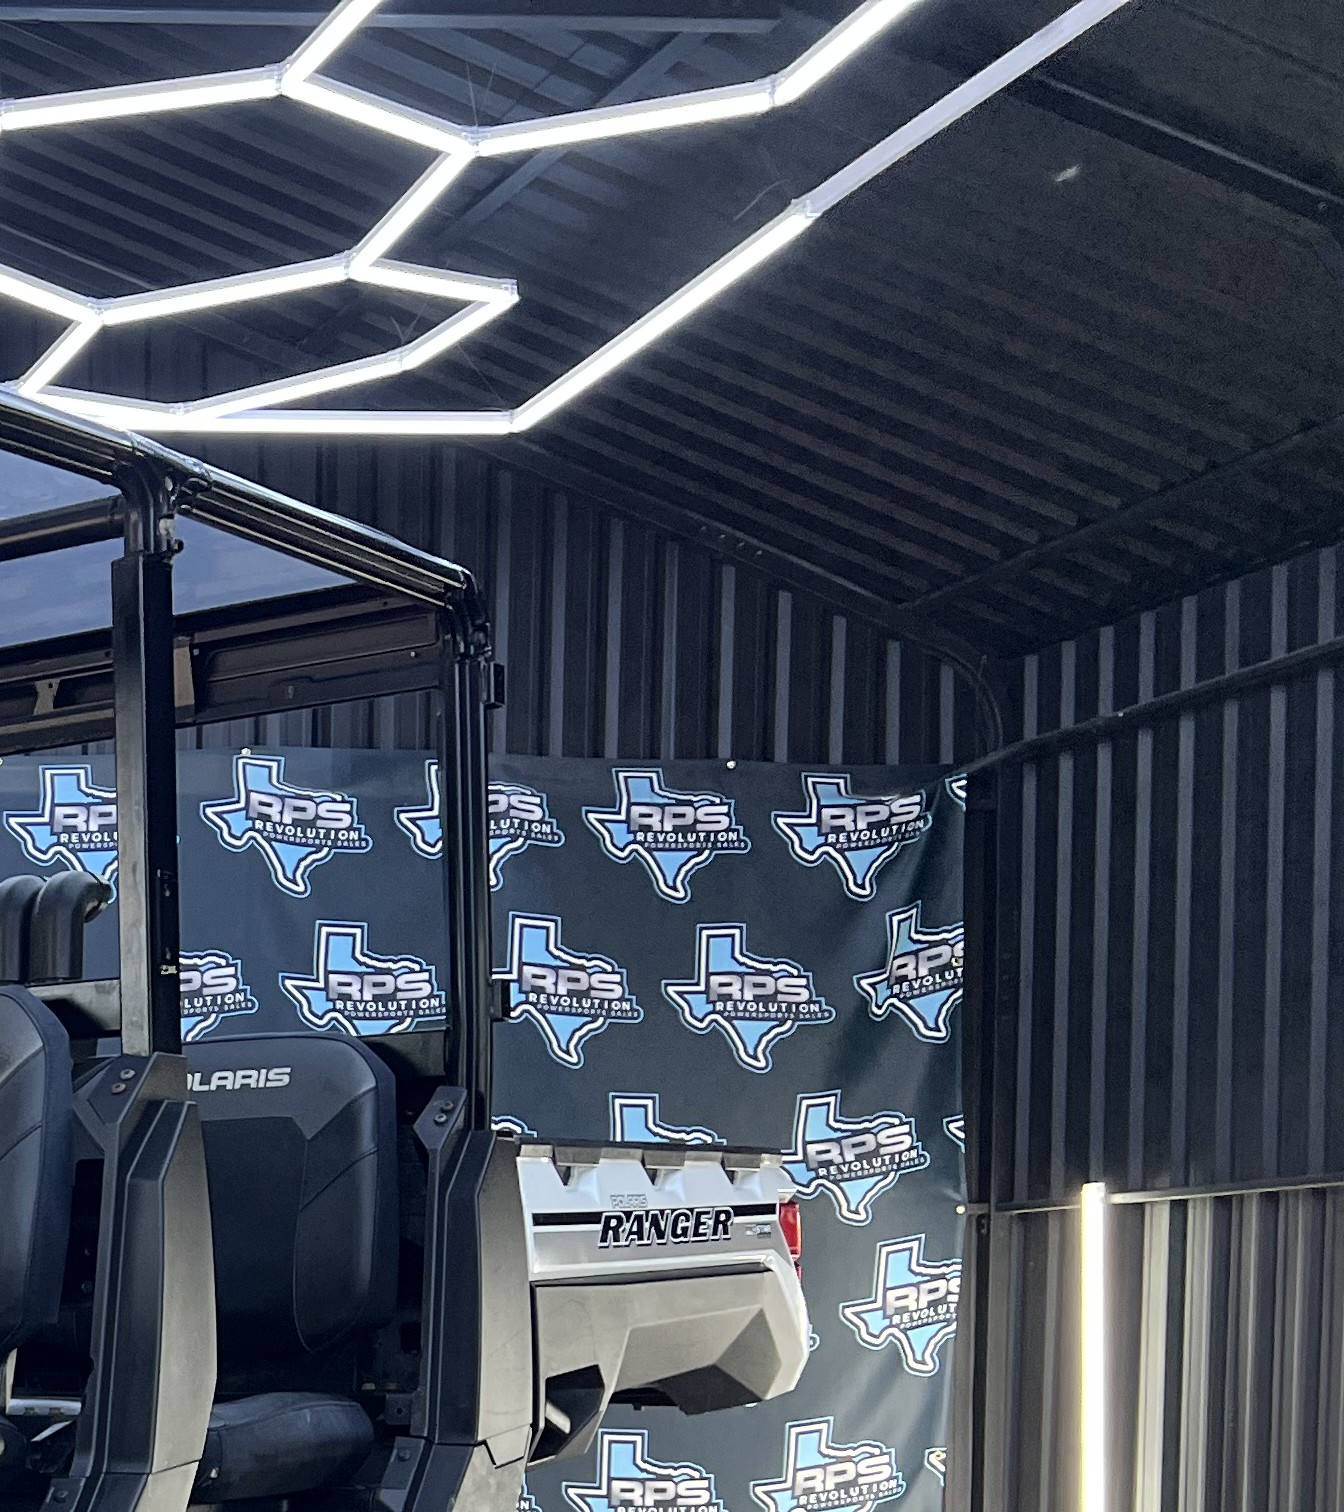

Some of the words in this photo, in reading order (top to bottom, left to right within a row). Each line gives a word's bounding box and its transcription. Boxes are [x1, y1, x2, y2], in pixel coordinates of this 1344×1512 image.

[54, 805, 118, 832] RP
[249, 793, 350, 828] RPS
[488, 793, 543, 820] PS
[631, 806, 729, 831] RPS
[821, 795, 921, 833] RPS
[255, 822, 358, 840] REVOLUTION
[490, 818, 551, 833] LUTION
[636, 831, 737, 841] REVOLUTION
[179, 967, 237, 995] PS
[329, 972, 430, 999] RPS
[522, 965, 622, 999] RPS
[710, 977, 811, 1002] RPS
[184, 992, 244, 1008] LUTION
[336, 999, 440, 1010] REVOLUTION
[529, 992, 631, 1011] REVOLUTION
[716, 1002, 820, 1013] REVOLUTION
[187, 1067, 291, 1091] LARIS
[808, 1125, 913, 1168] RPS
[818, 1149, 918, 1176] REVOLUTION
[598, 1206, 735, 1248] RANGER
[892, 1303, 957, 1324] REVOLUT
[795, 1454, 891, 1493] RPS
[611, 1480, 710, 1506] RPS
[801, 1478, 898, 1506] REVOLUTION
